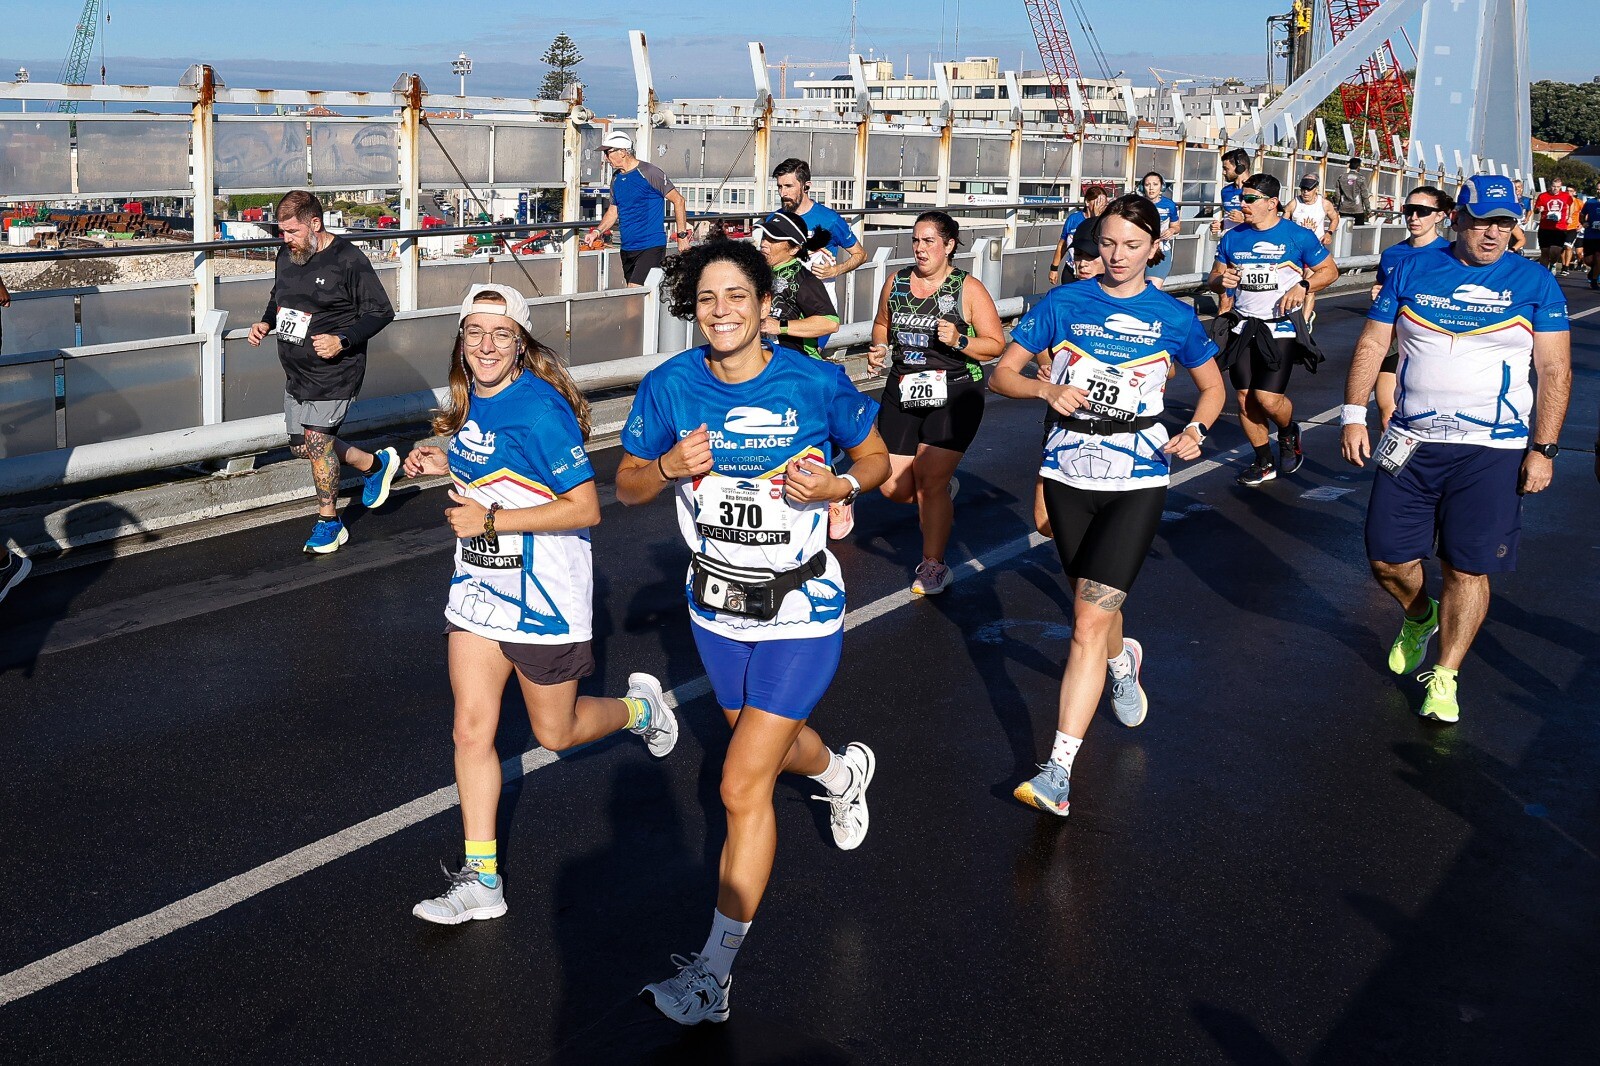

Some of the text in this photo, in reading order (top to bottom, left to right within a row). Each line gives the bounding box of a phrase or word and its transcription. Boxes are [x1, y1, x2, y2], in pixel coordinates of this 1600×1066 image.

[1246, 273, 1269, 284] 1367
[1415, 293, 1451, 304] CORRIDA
[1452, 314, 1487, 322] CORRIDA
[279, 319, 297, 334] 927
[1071, 323, 1104, 332] CORRIDA
[896, 331, 929, 348] SNR
[1090, 341, 1138, 353] UMA CORRIDA
[1110, 351, 1131, 359] IGUAL
[909, 384, 933, 399] 226
[1086, 378, 1120, 405] 733
[731, 455, 772, 463] CORRIDA
[719, 501, 762, 529] 370
